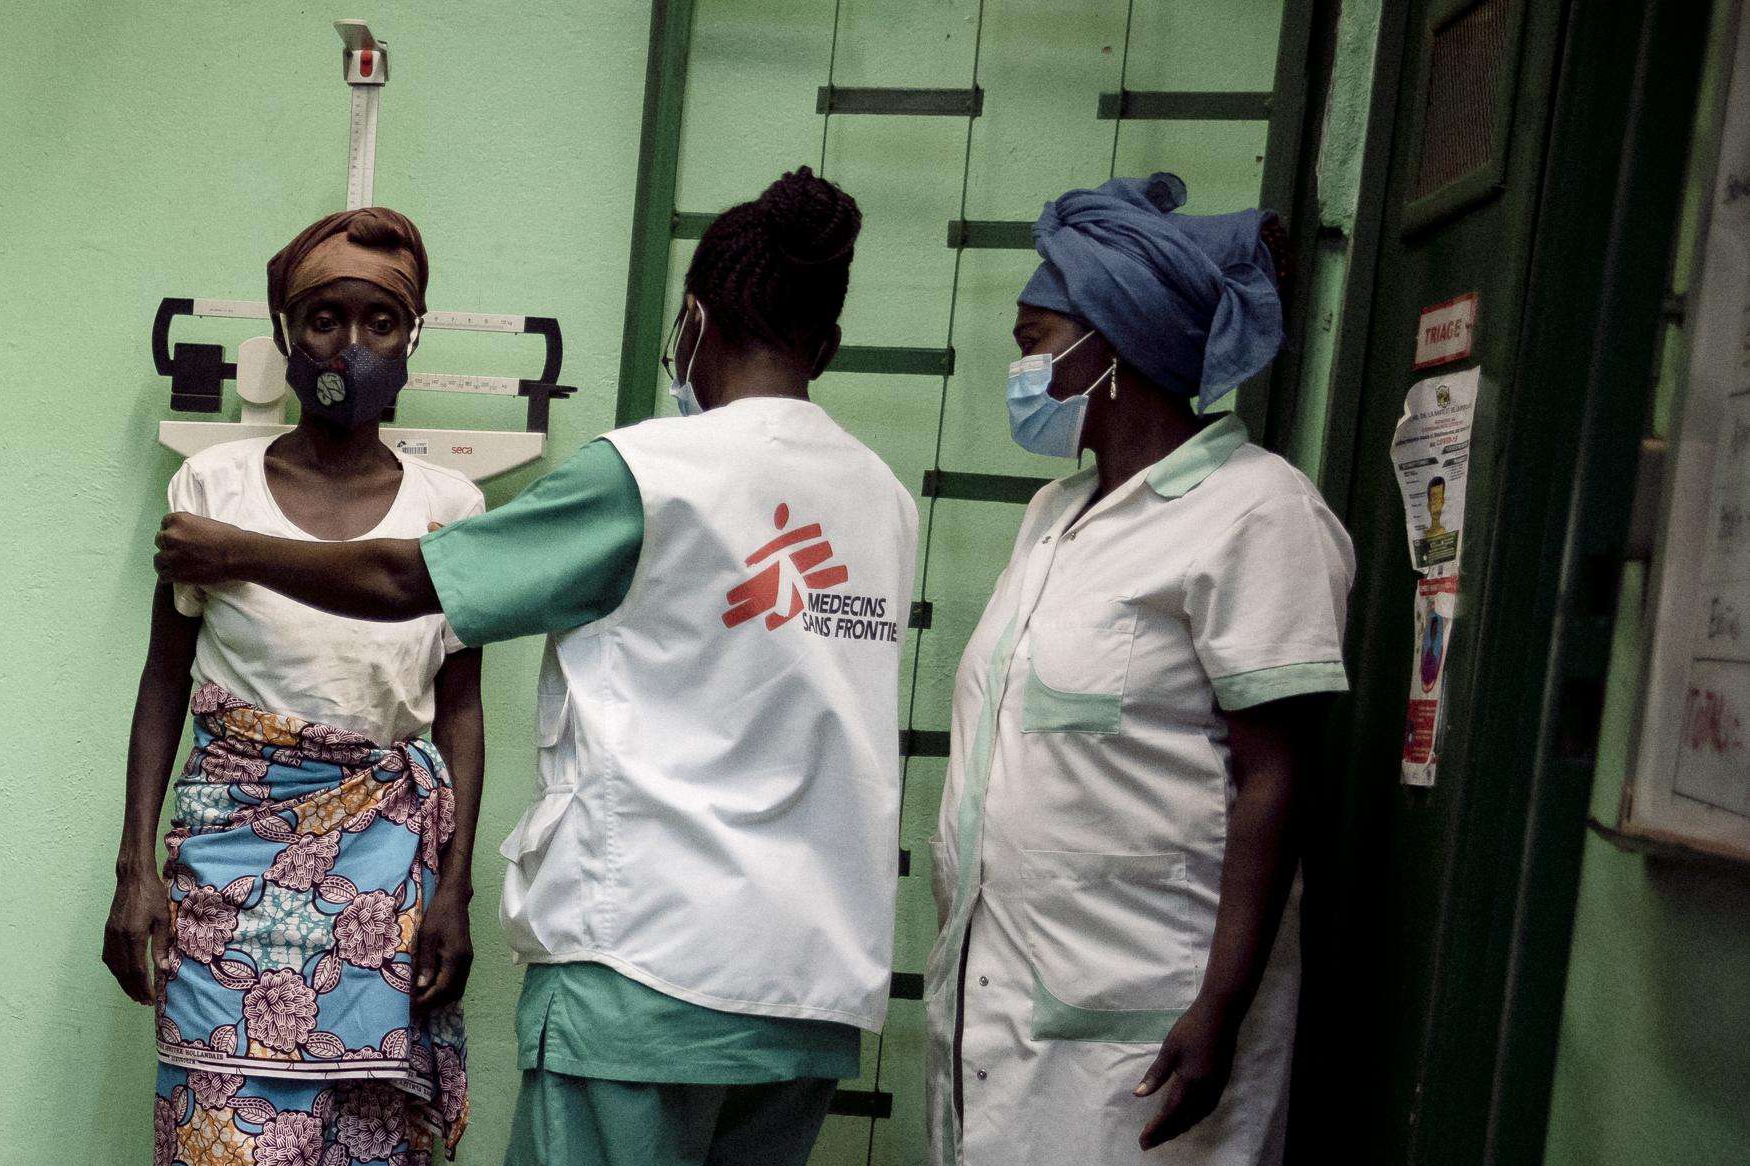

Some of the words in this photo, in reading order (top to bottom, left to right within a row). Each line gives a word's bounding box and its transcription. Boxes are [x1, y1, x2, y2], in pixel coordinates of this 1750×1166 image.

[1425, 319, 1462, 346] TRIAGE
[451, 445, 473, 455] seca
[808, 592, 887, 618] MEDECINS
[802, 611, 832, 637] SANS
